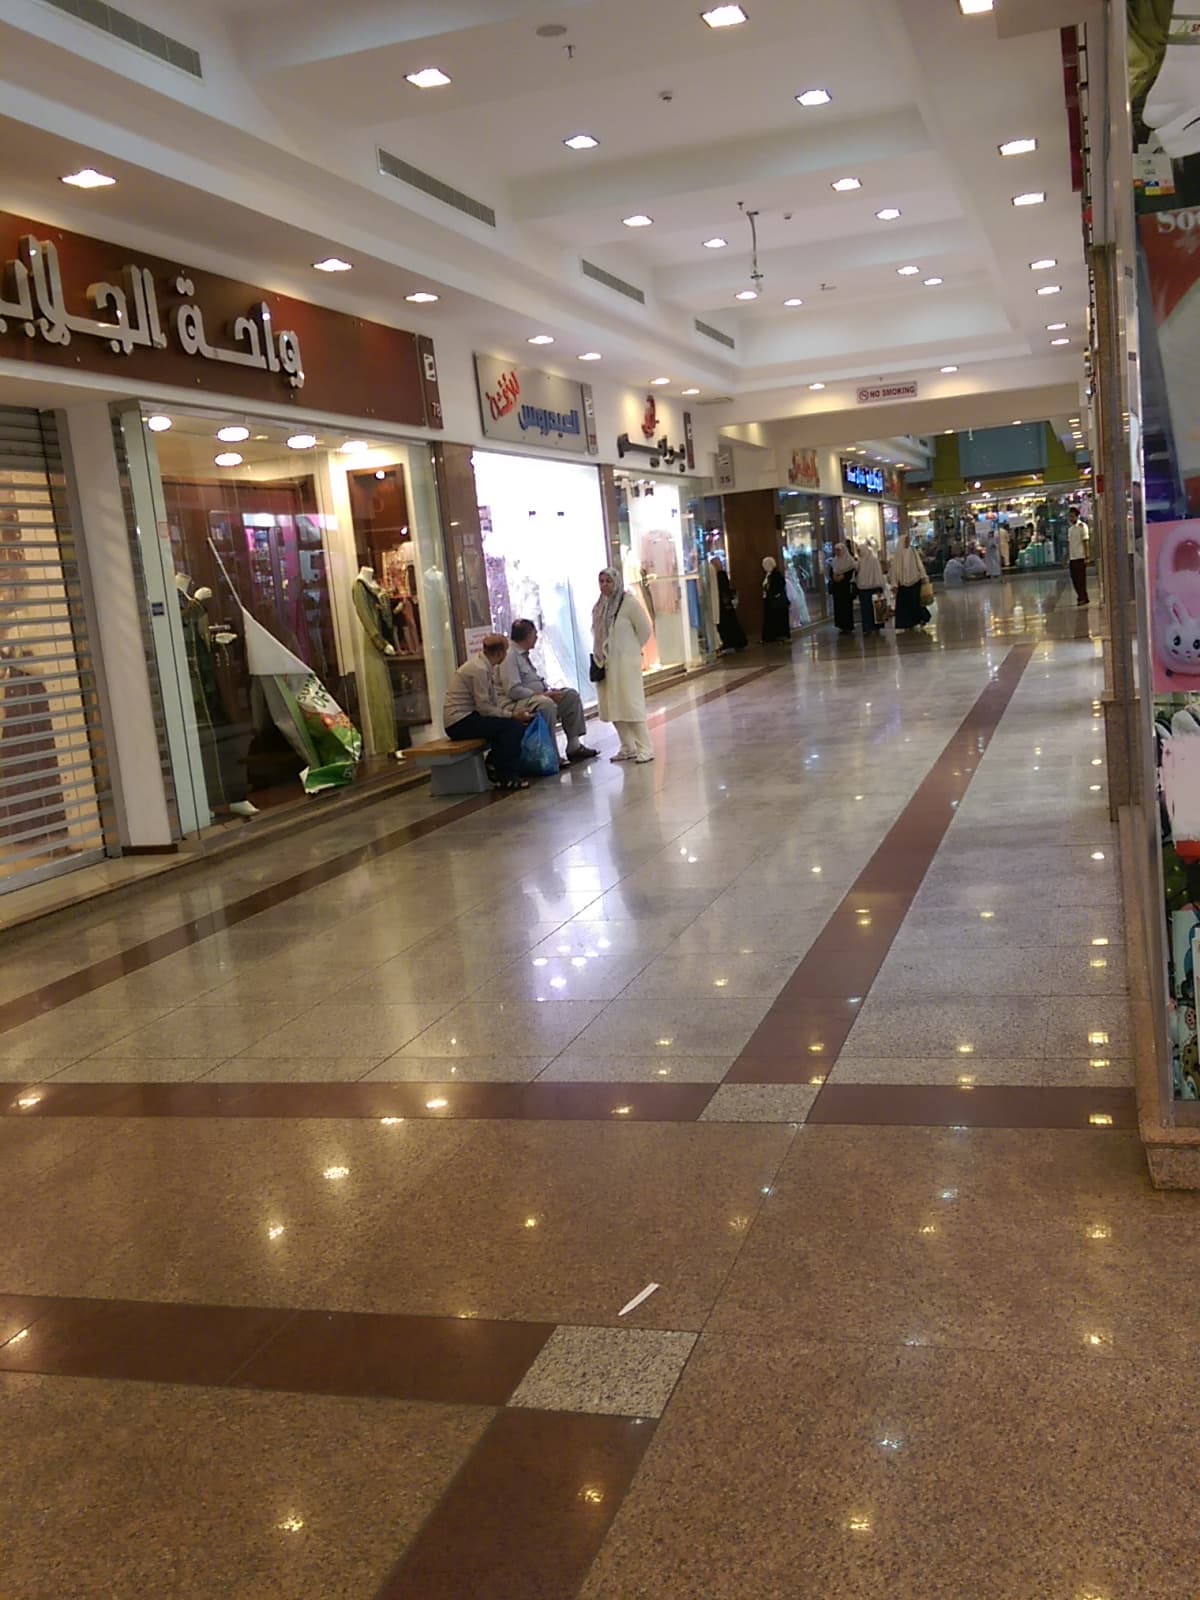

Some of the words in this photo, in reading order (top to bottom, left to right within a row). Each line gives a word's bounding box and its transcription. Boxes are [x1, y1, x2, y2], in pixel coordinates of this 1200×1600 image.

[0, 234, 167, 355] الجلاب
[174, 271, 305, 388] واحة
[870, 390, 881, 398] NO
[882, 386, 915, 397] SMOKING
